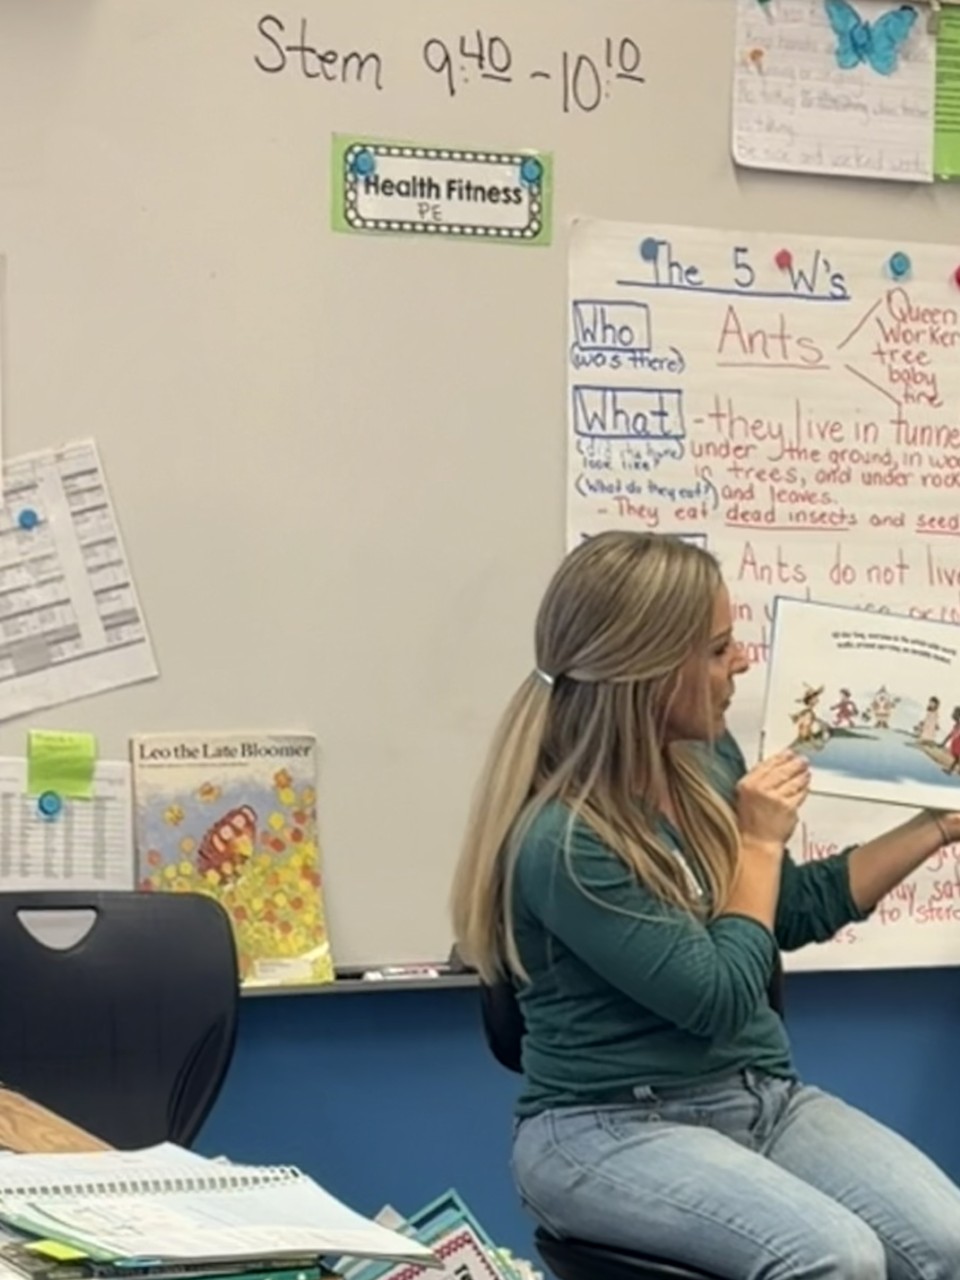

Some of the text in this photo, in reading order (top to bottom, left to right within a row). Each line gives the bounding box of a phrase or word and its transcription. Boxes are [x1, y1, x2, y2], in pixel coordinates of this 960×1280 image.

[254, 14, 382, 90] Stem
[364, 174, 523, 206] Health Fitness
[417, 202, 443, 222] PE
[653, 241, 848, 296] The 5 W's
[576, 303, 635, 346] Who
[886, 287, 958, 324] Queen
[717, 306, 824, 364] Ants
[872, 342, 931, 366] tree
[888, 363, 938, 402] baby
[578, 388, 670, 437] What
[795, 398, 844, 446] live
[854, 417, 880, 444] in
[691, 440, 755, 461] under
[784, 437, 820, 461] the
[828, 447, 898, 475] ground,
[903, 451, 923, 467] in
[726, 462, 805, 487] trees,
[815, 466, 852, 485] and
[862, 467, 914, 487] under
[721, 484, 755, 501] and
[615, 495, 659, 526] They
[674, 500, 709, 522] eat
[725, 502, 776, 523] dead
[788, 507, 859, 526] insects
[869, 514, 905, 529] and
[738, 540, 808, 585] Ants
[830, 542, 857, 586] do
[867, 547, 911, 586] not
[139, 741, 312, 761] Leo the Late Bloomer
